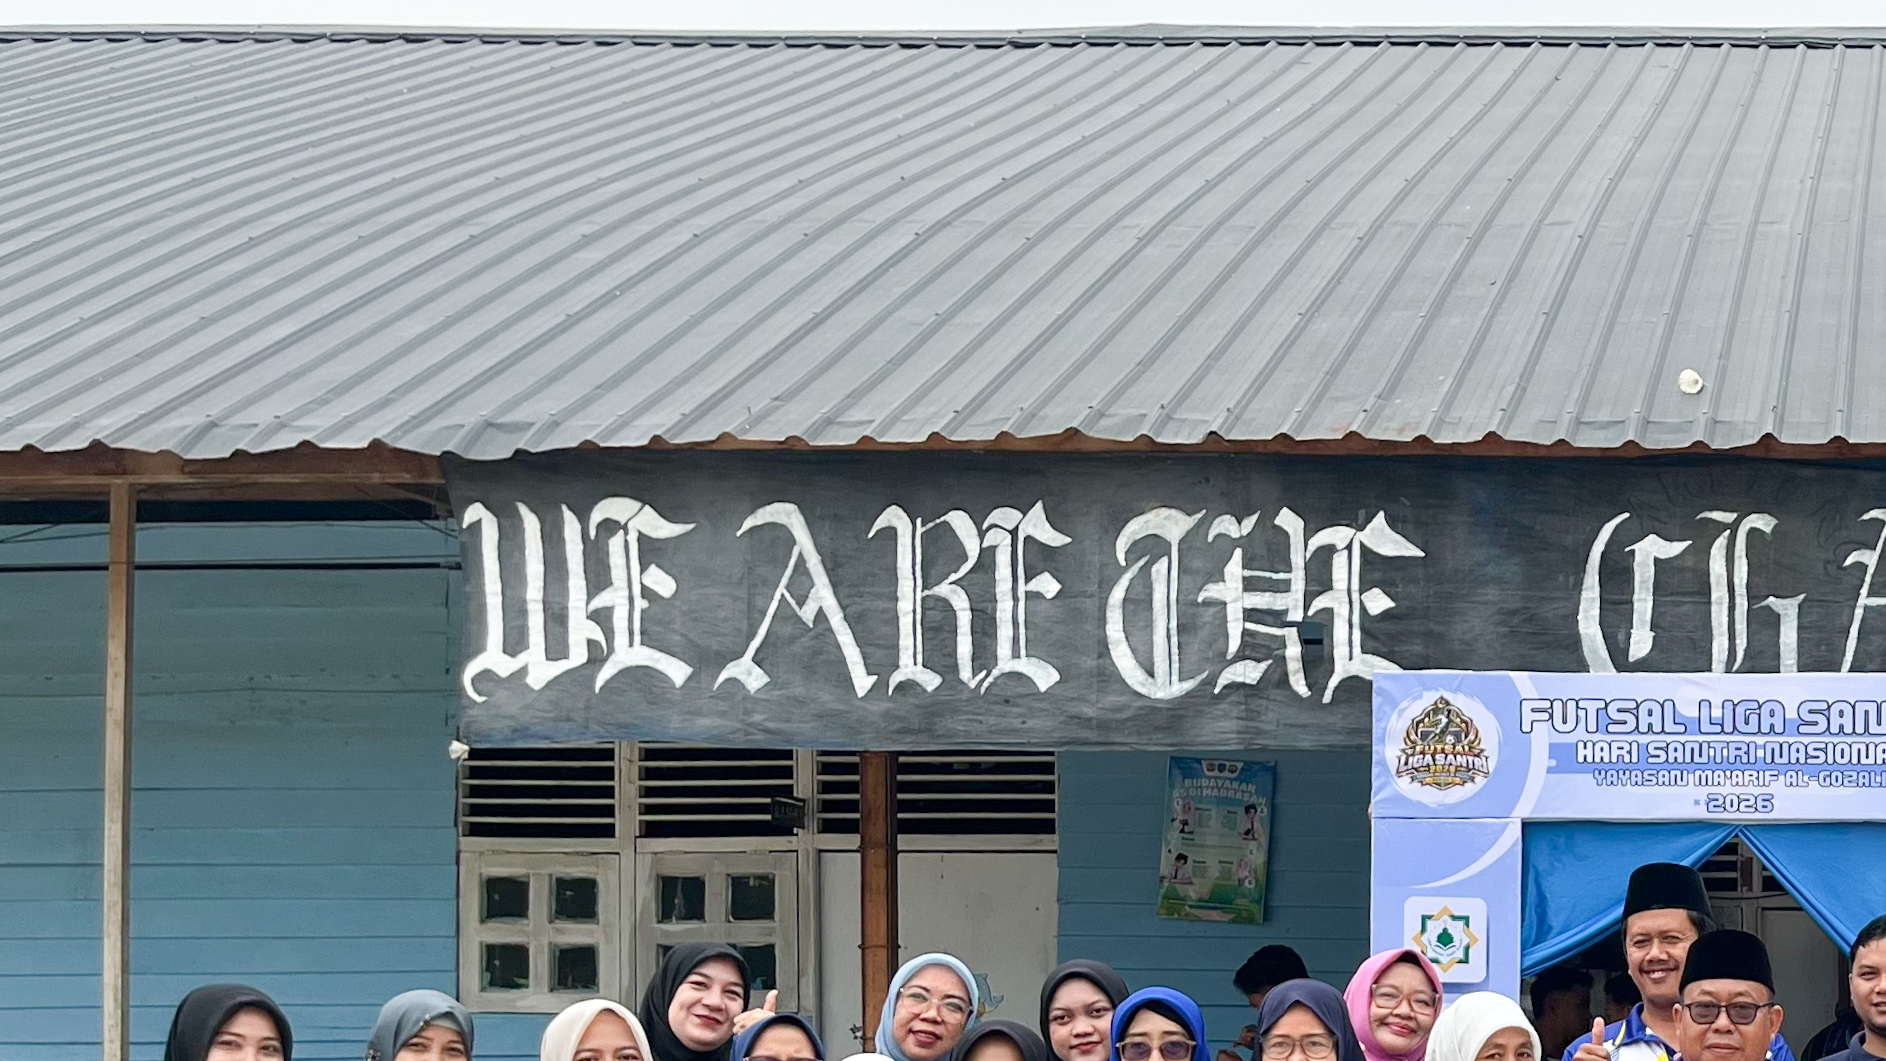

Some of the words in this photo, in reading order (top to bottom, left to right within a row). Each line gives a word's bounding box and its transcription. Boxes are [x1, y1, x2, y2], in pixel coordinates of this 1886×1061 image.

[461, 496, 697, 703] WE
[713, 499, 1072, 699] ARE
[1104, 503, 1425, 704] THE
[1520, 699, 1687, 734] FUTSAL
[1698, 699, 1785, 735] LIGA
[1399, 754, 1434, 771] LIGA
[1434, 753, 1488, 772] SANTRI
[1576, 741, 1639, 764] HARI
[1646, 741, 1758, 764] SANTRI
[1184, 778, 1257, 793] BUDAYAKAN
[1593, 770, 1688, 787] YAYASAN
[1694, 769, 1780, 787] MA'ARIF
[1785, 770, 1886, 788] AL-GOZALI
[1707, 793, 1775, 813] 2026
